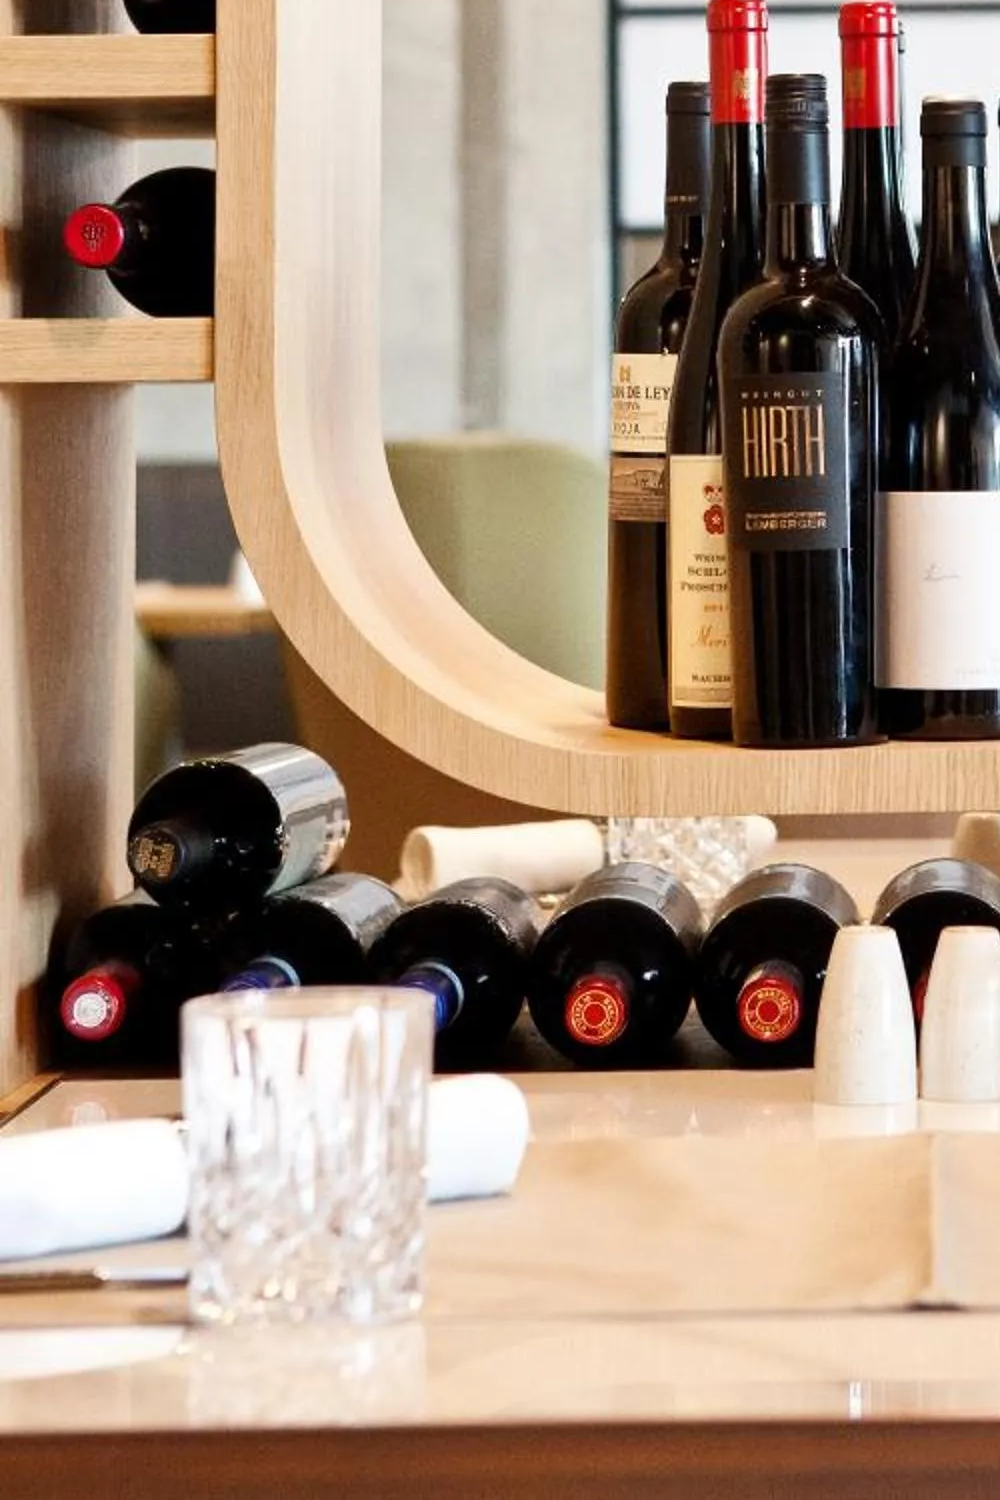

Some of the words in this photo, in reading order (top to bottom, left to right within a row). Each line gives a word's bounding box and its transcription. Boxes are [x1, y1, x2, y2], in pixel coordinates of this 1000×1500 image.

[645, 387, 671, 400] LEY
[742, 404, 825, 477] HIRTH
[745, 518, 827, 531] LEMBERGER
